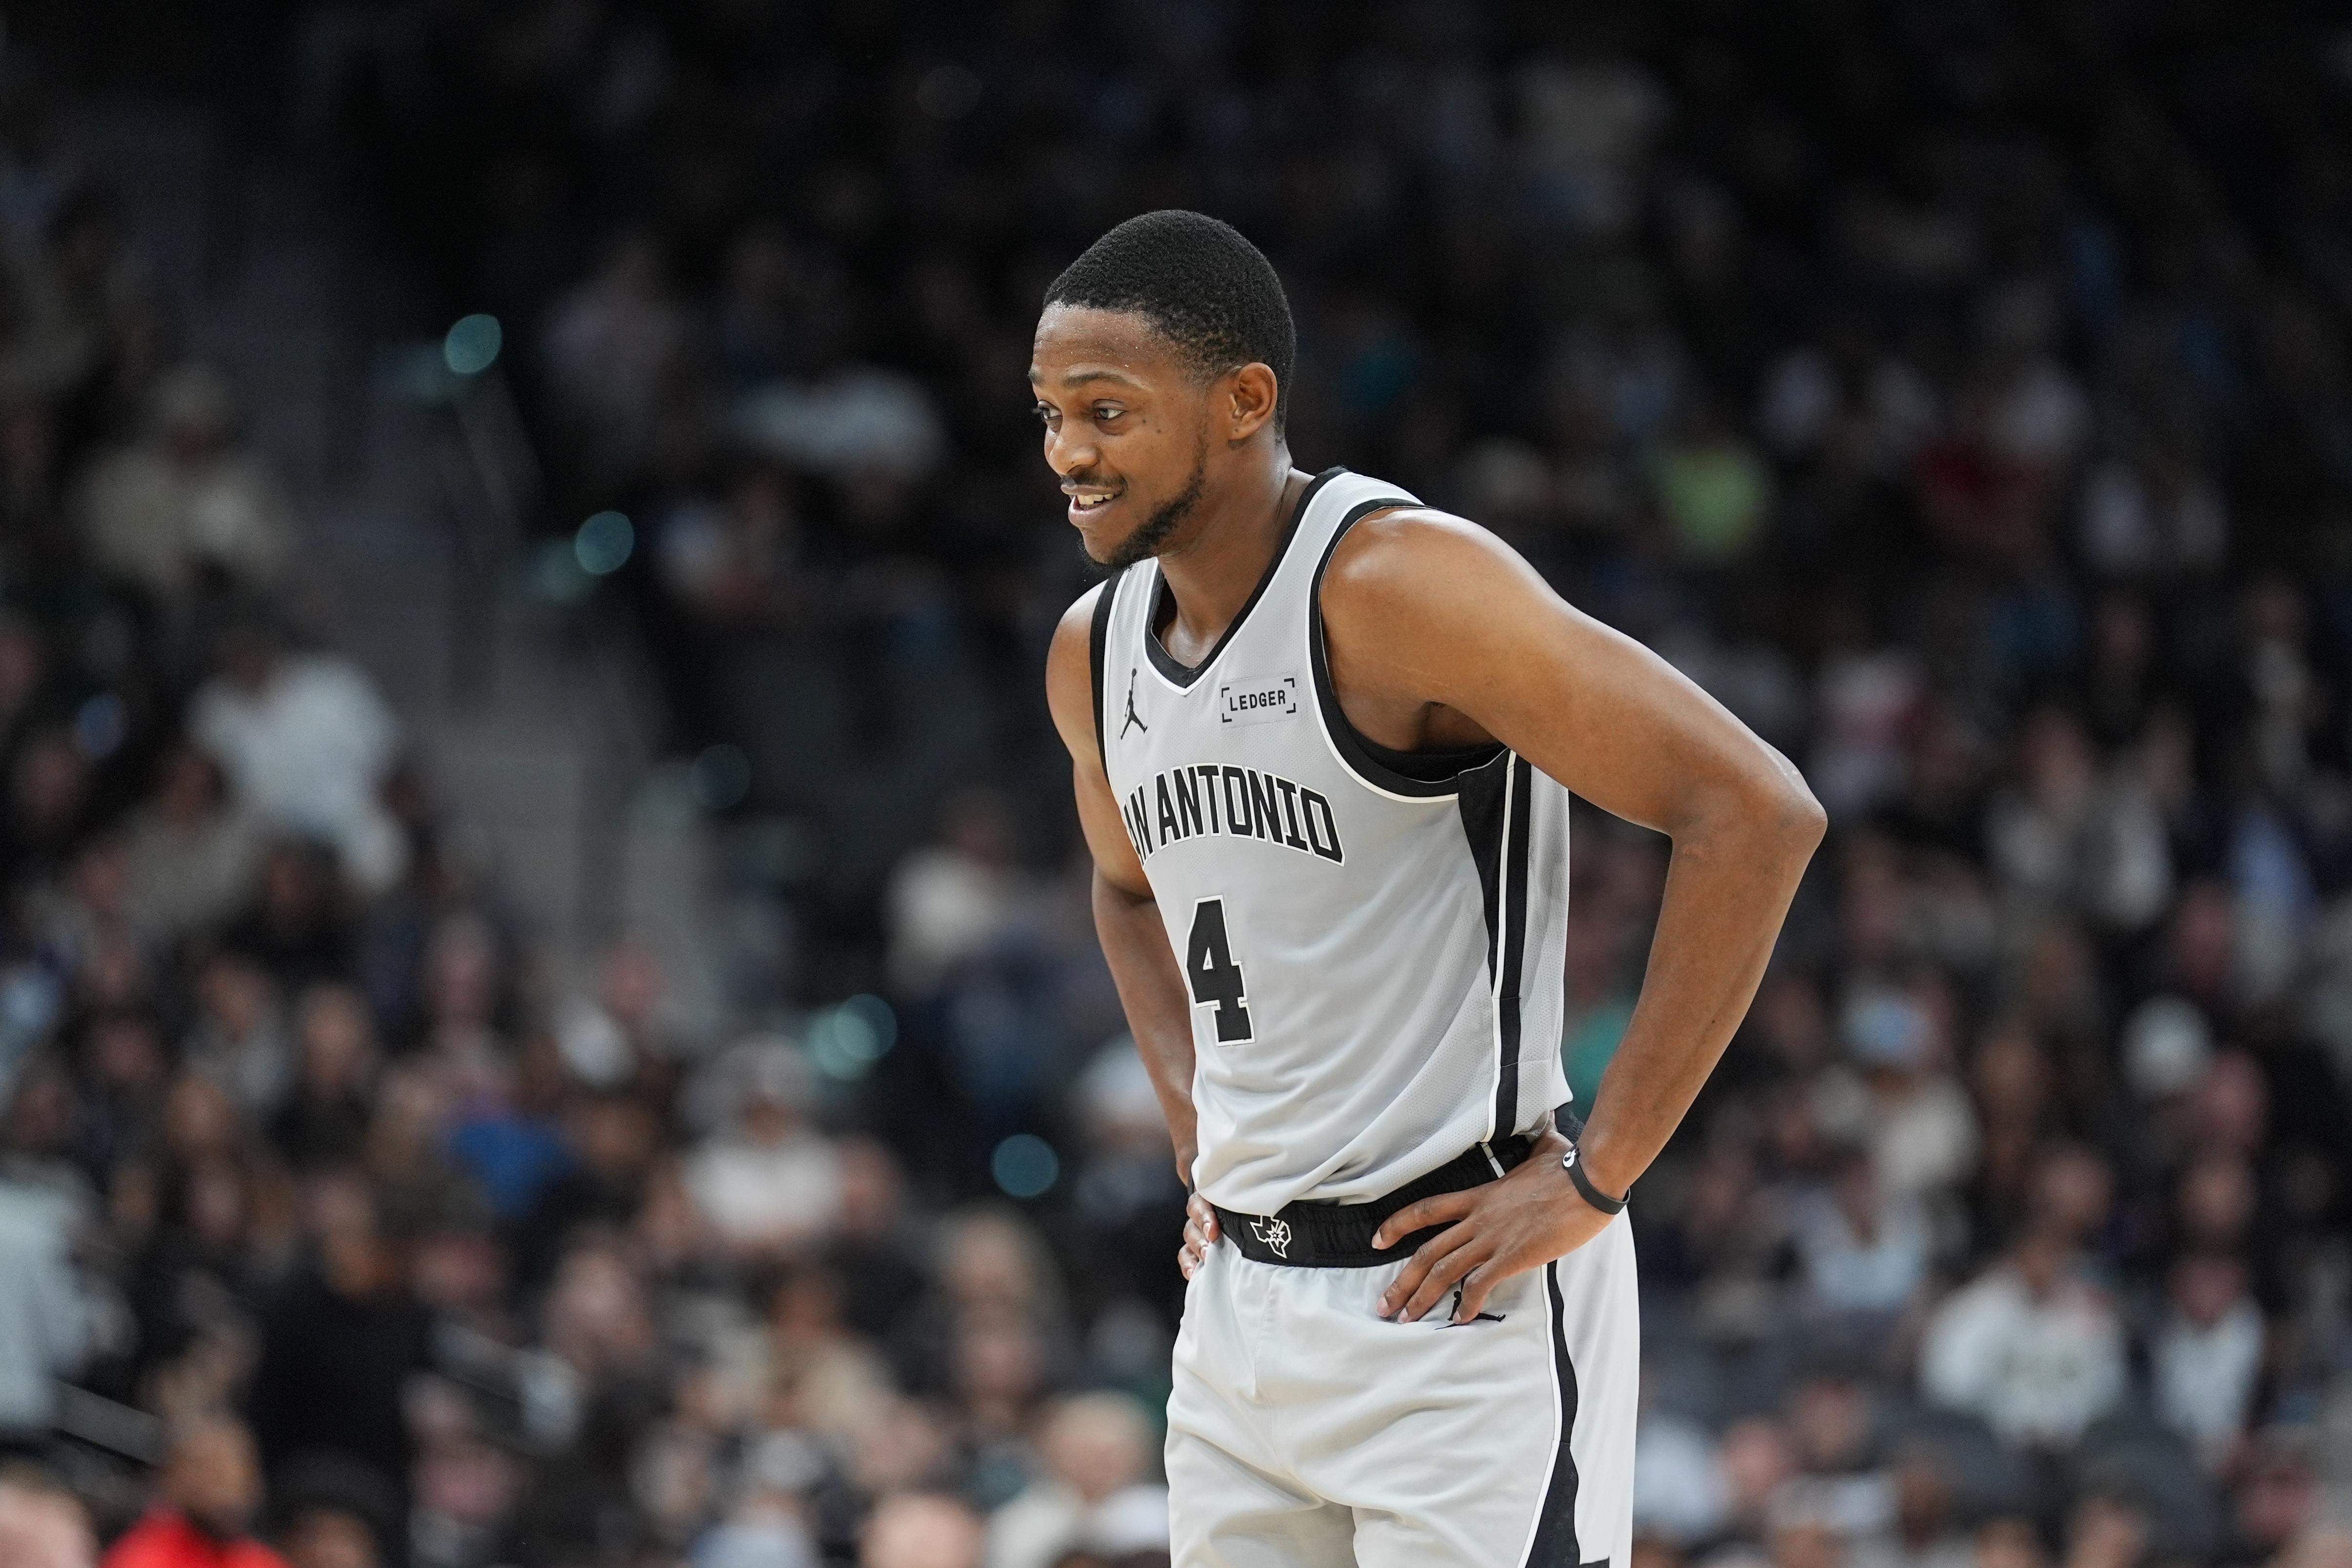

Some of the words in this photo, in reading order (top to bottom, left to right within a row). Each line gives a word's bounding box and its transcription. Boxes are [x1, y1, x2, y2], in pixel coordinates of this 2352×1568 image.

[1229, 689, 1286, 711] LEDGER
[1155, 763, 1345, 866] ANTONIO
[1185, 895, 1255, 1046] 4
